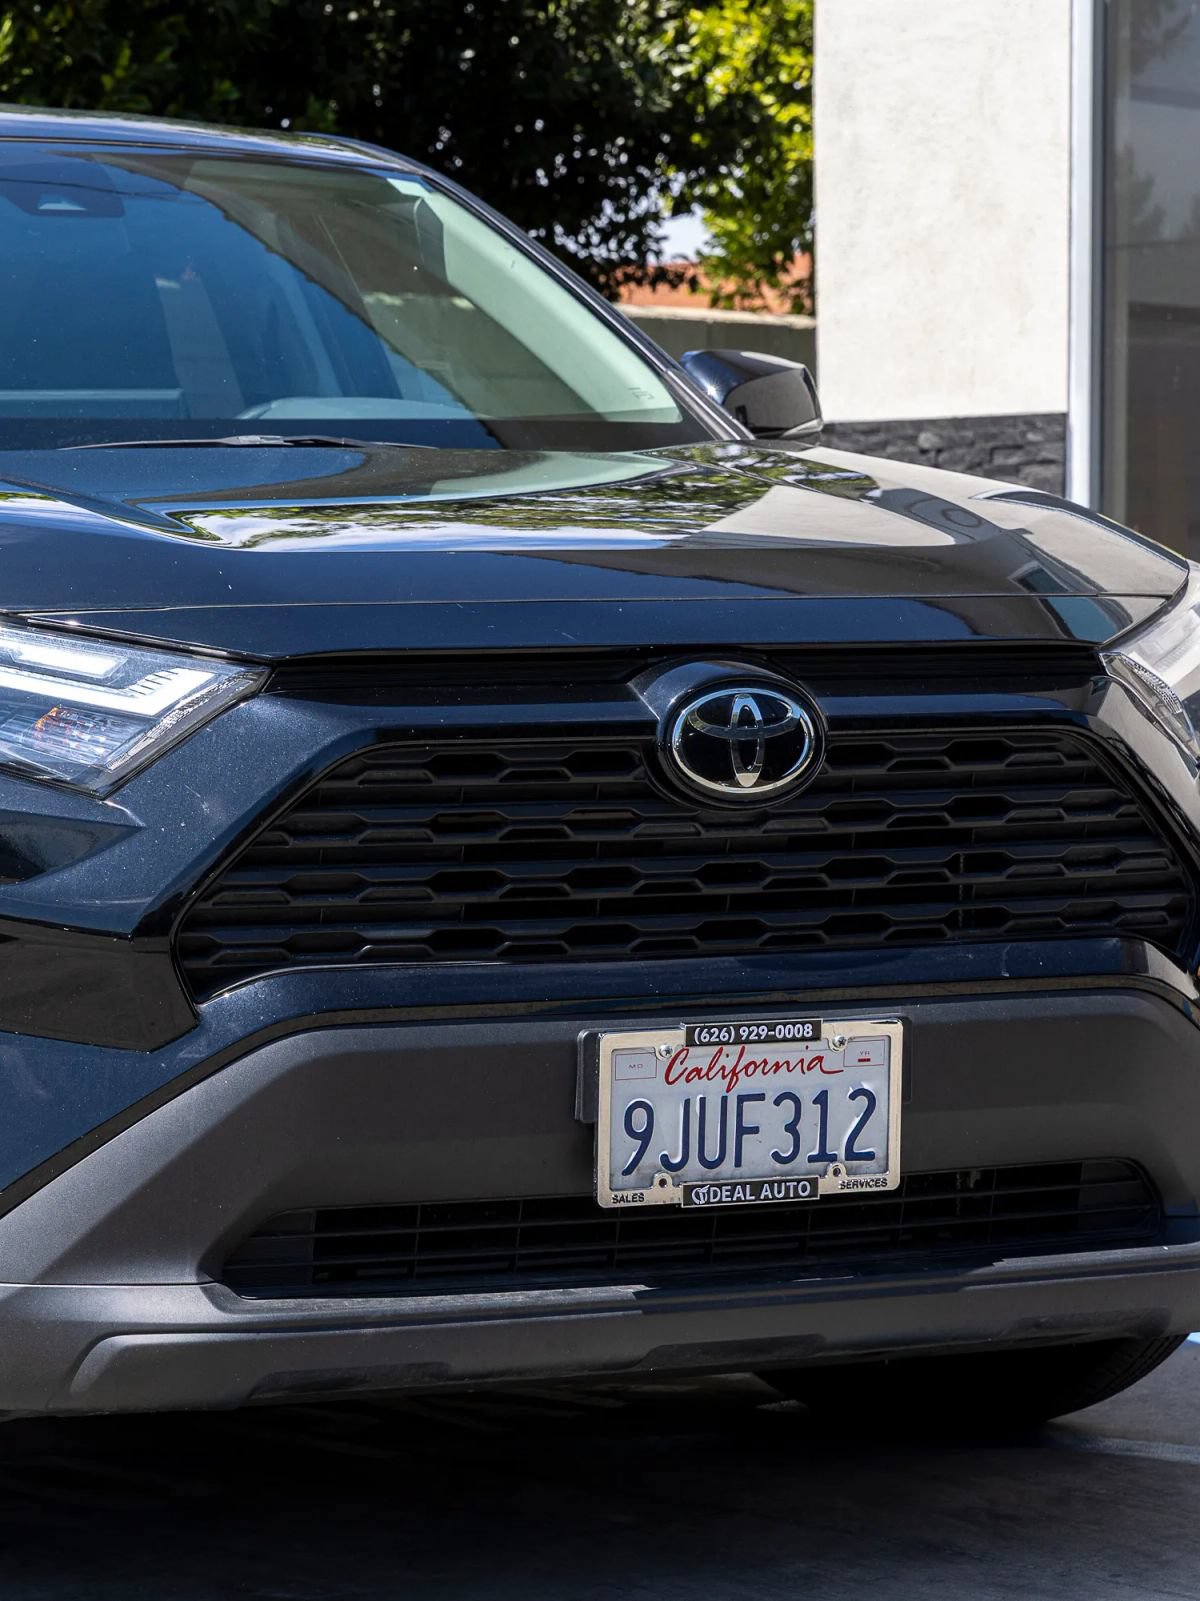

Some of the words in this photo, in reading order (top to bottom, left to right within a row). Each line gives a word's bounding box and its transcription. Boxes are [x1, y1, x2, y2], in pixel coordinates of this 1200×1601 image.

[694, 1025, 734, 1044] (626)
[739, 1024, 813, 1041] 929-0008
[664, 1045, 844, 1093] California
[621, 1087, 877, 1177] 9JUF312
[760, 1180, 811, 1199] AUTO
[838, 1178, 888, 1190] SERVICES
[611, 1192, 645, 1204] SALES
